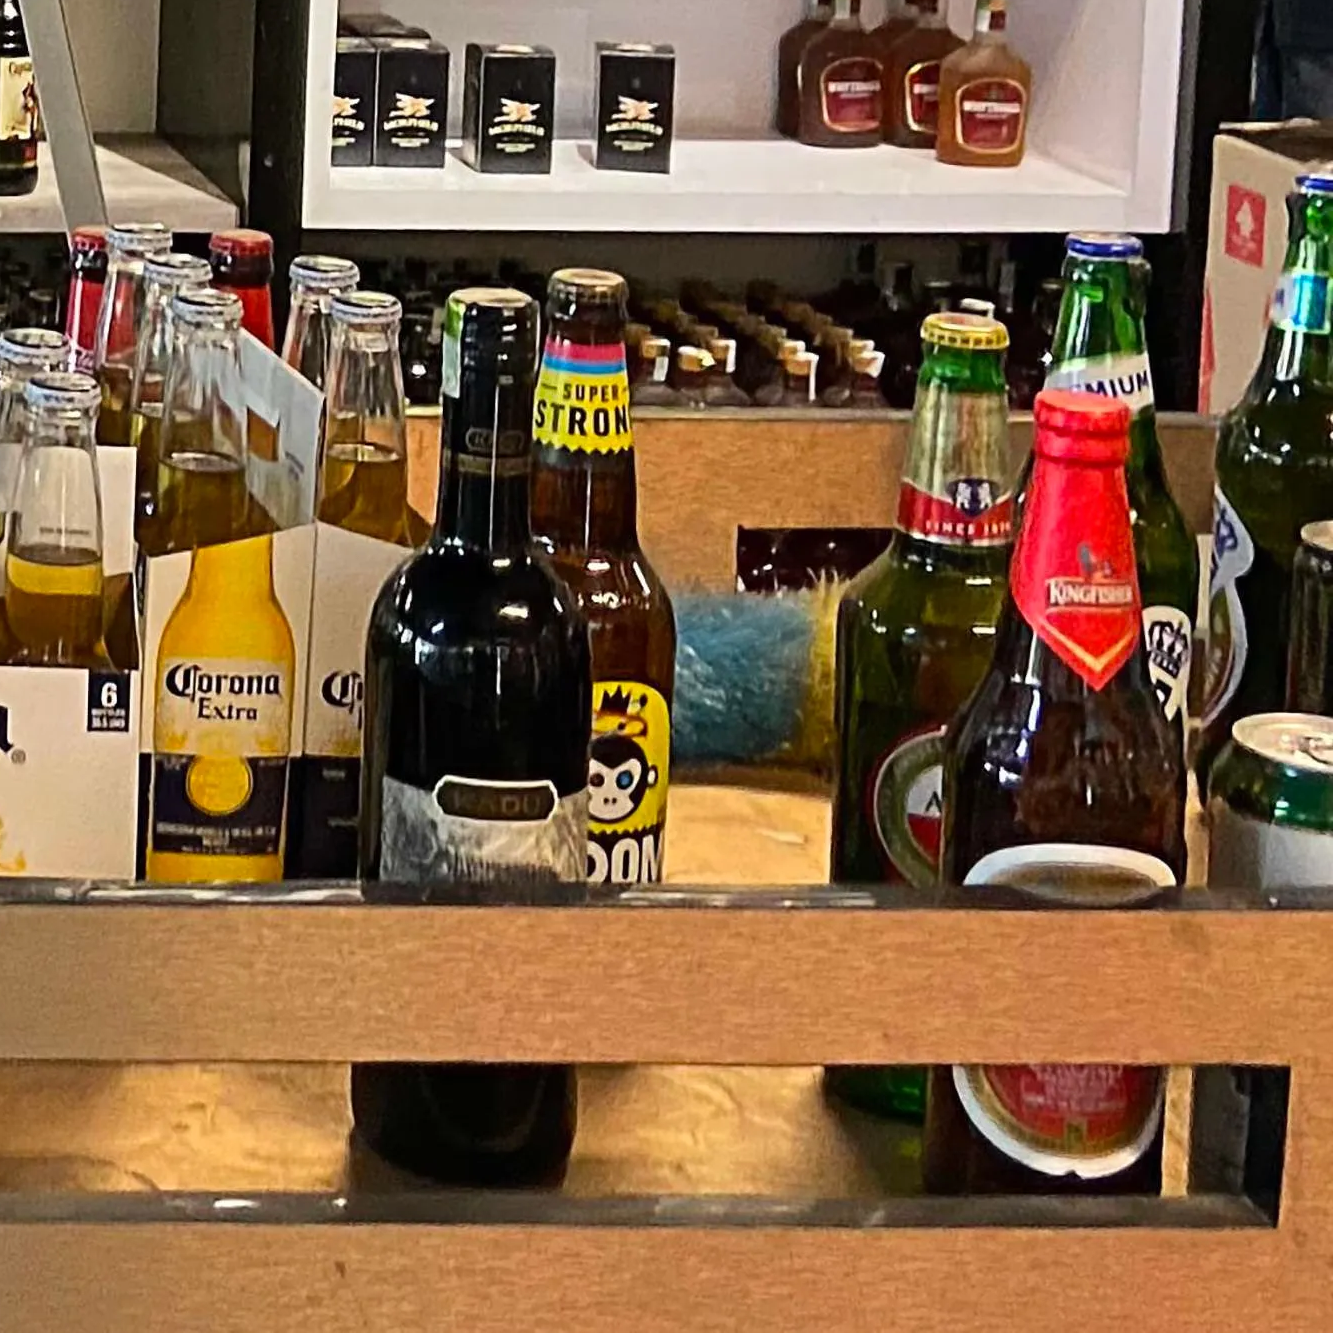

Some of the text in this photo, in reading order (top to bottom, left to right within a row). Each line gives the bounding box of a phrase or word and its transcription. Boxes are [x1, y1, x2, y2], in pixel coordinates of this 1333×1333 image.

[563, 383, 620, 400] SUPER
[535, 398, 631, 438] STRON
[925, 520, 975, 536] SINCE
[1049, 580, 1133, 605] KINGFISHER
[100, 681, 118, 708] 6
[166, 662, 281, 702] Corona
[197, 697, 258, 722] Extra
